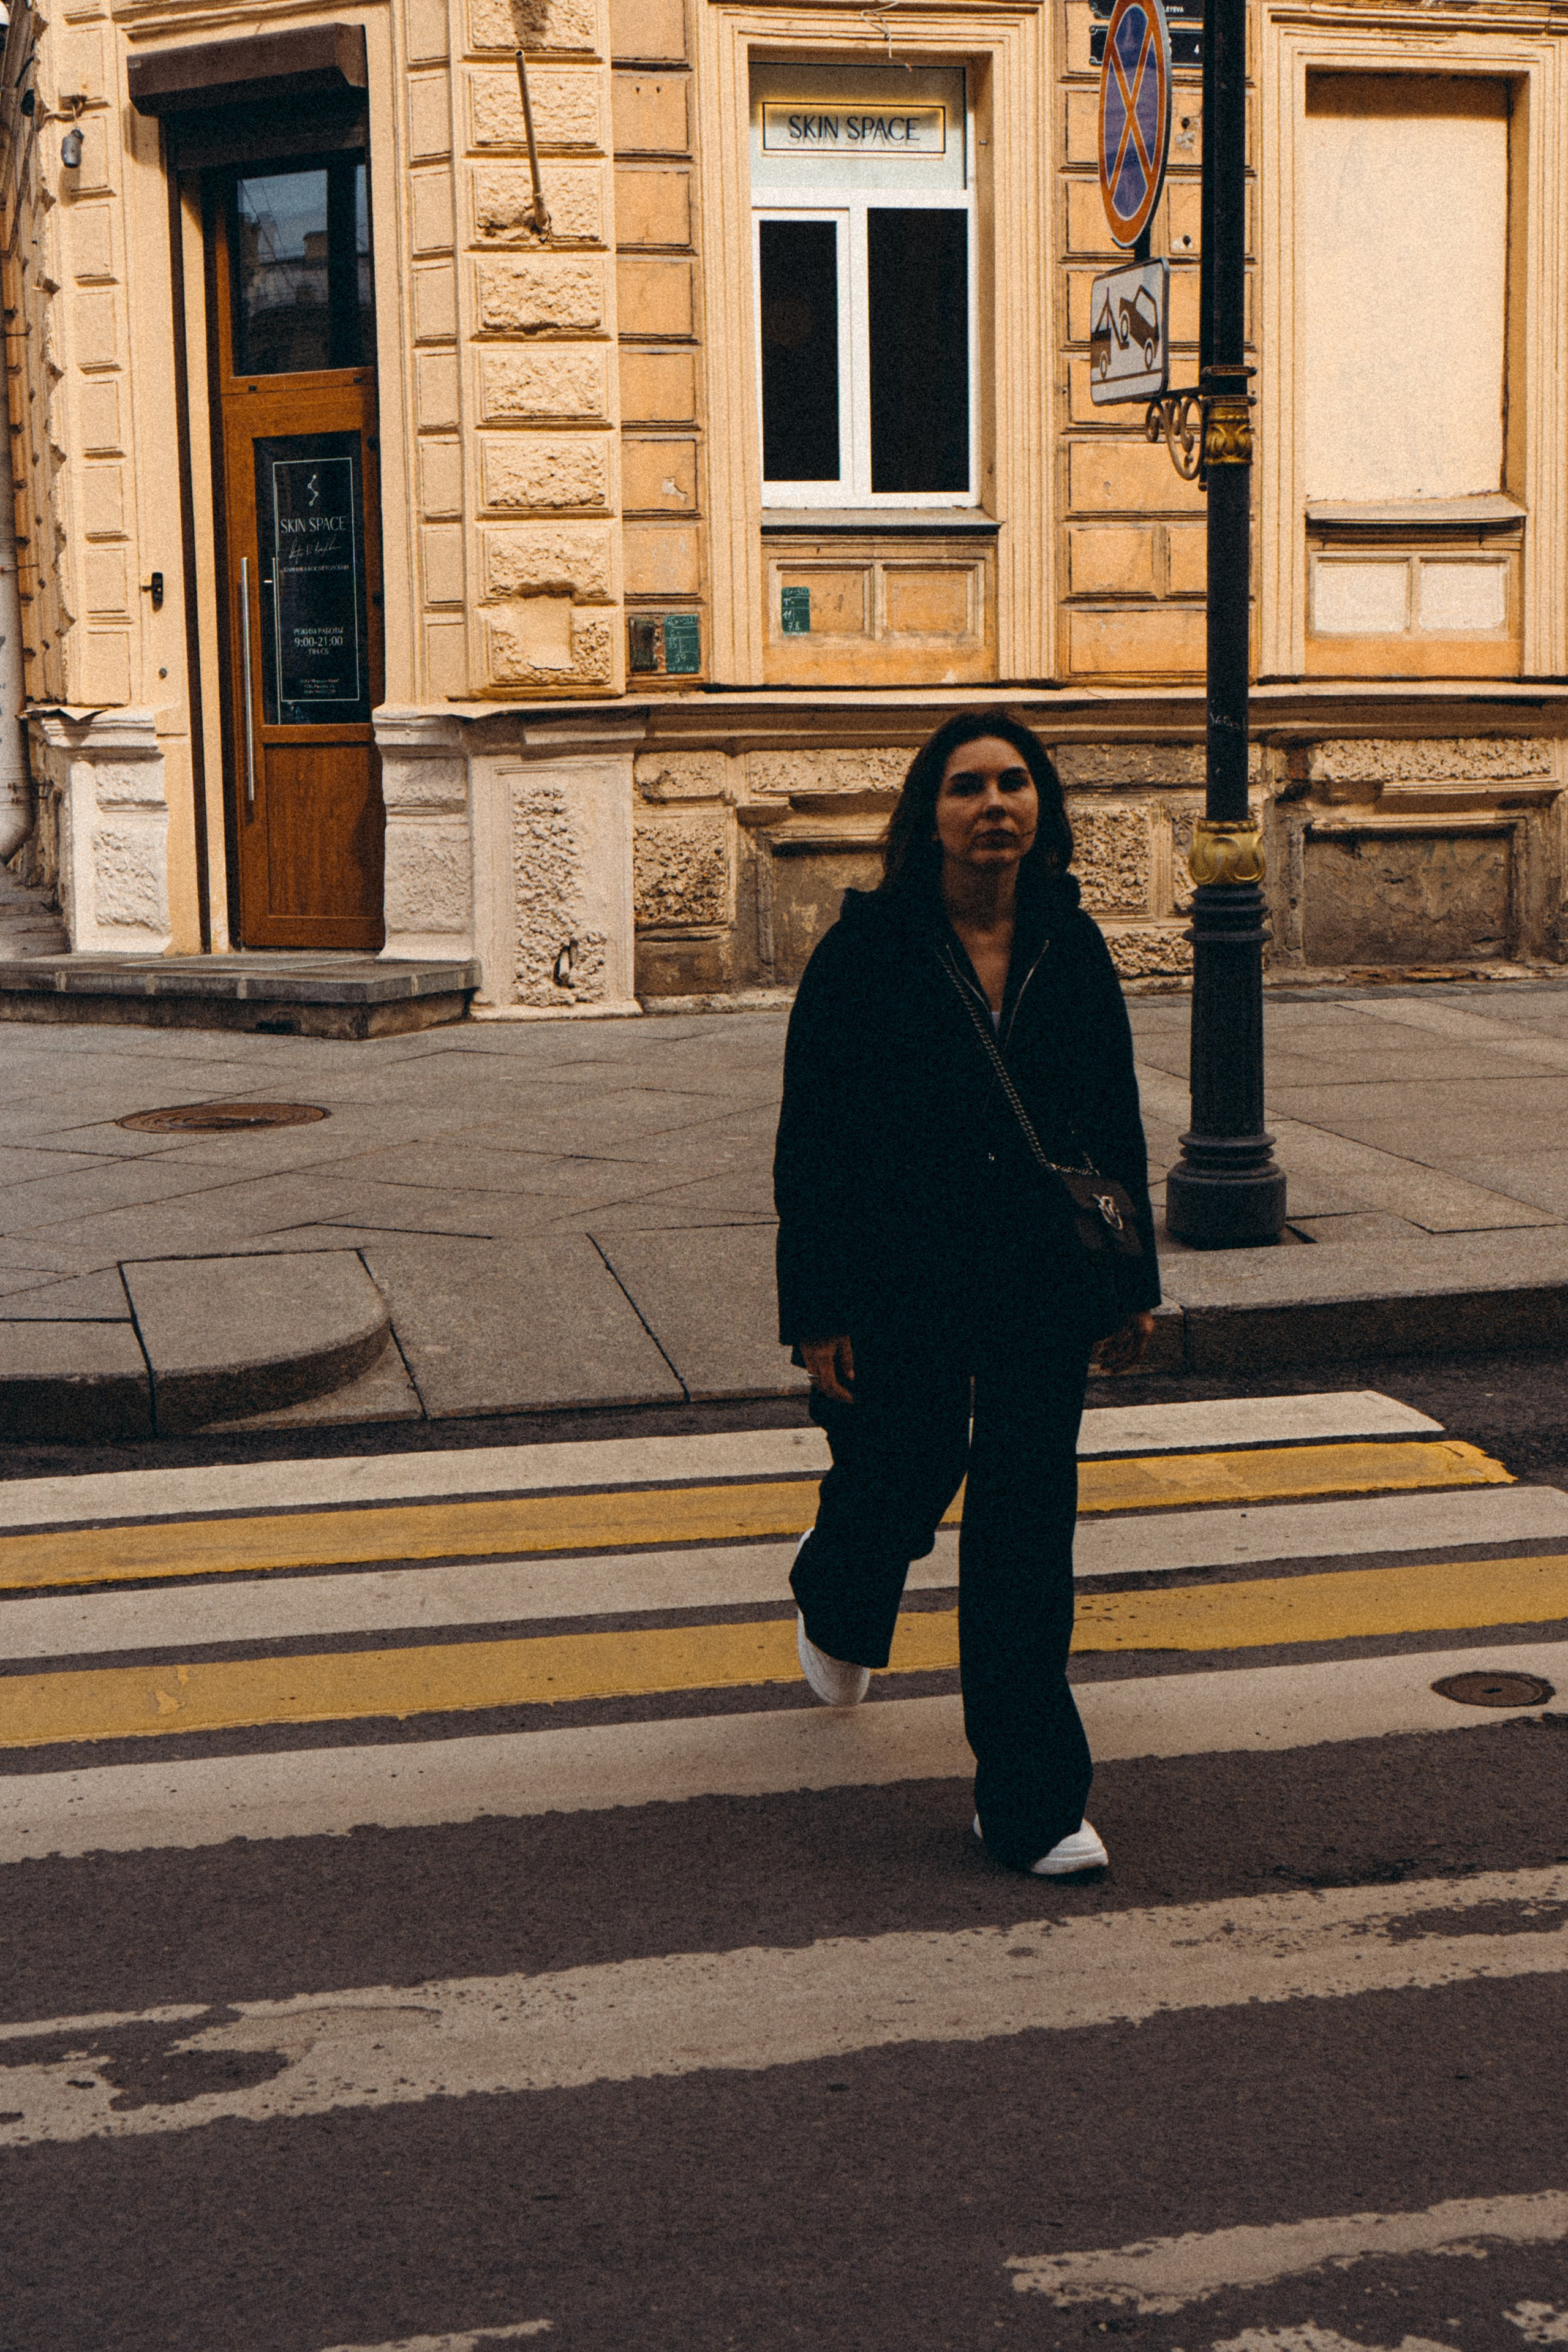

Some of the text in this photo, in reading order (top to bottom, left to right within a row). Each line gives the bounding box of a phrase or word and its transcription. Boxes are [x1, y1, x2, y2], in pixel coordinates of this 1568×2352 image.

[789, 115, 920, 141] SKIN SPACE
[281, 516, 347, 533] SKIN SPACE
[294, 636, 344, 647] 9:00-21:00
